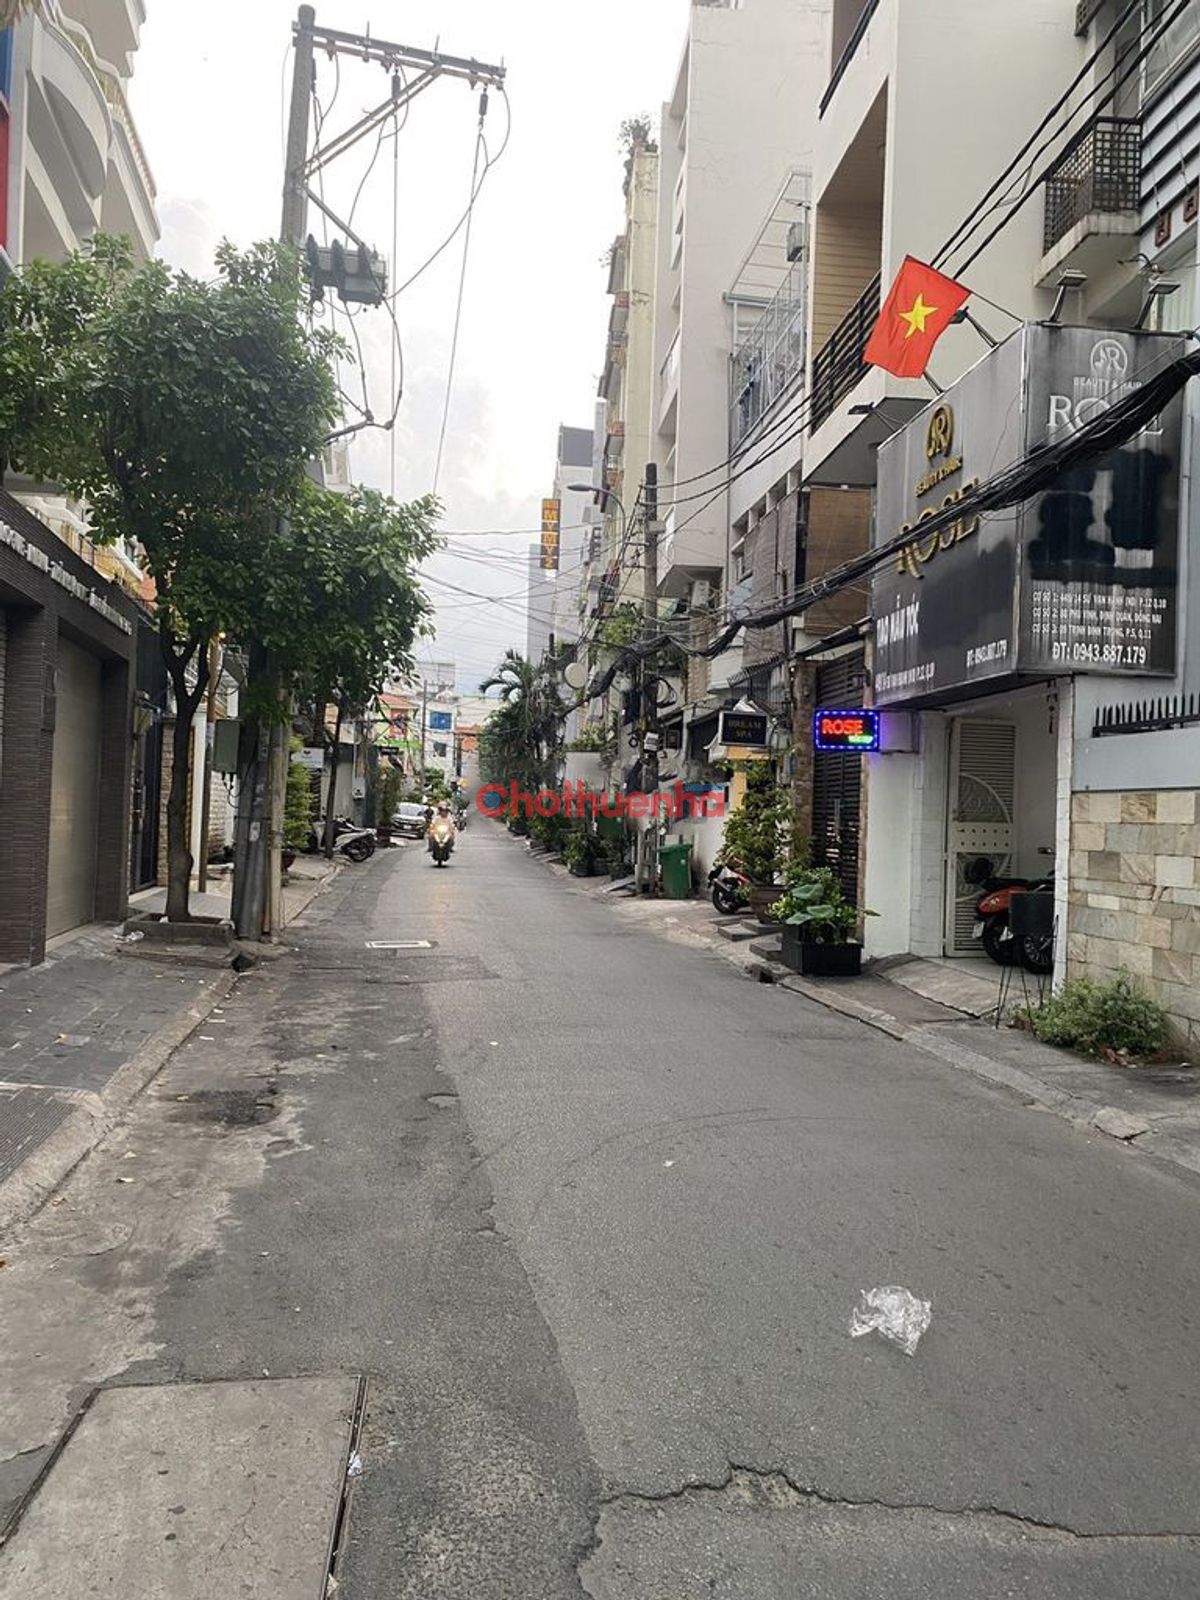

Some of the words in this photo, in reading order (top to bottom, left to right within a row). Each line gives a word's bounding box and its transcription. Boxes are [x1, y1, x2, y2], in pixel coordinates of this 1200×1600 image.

[1052, 641, 1071, 660] ĐT:
[1073, 642, 1147, 664] 0943.887.179
[821, 718, 864, 735] ROSE
